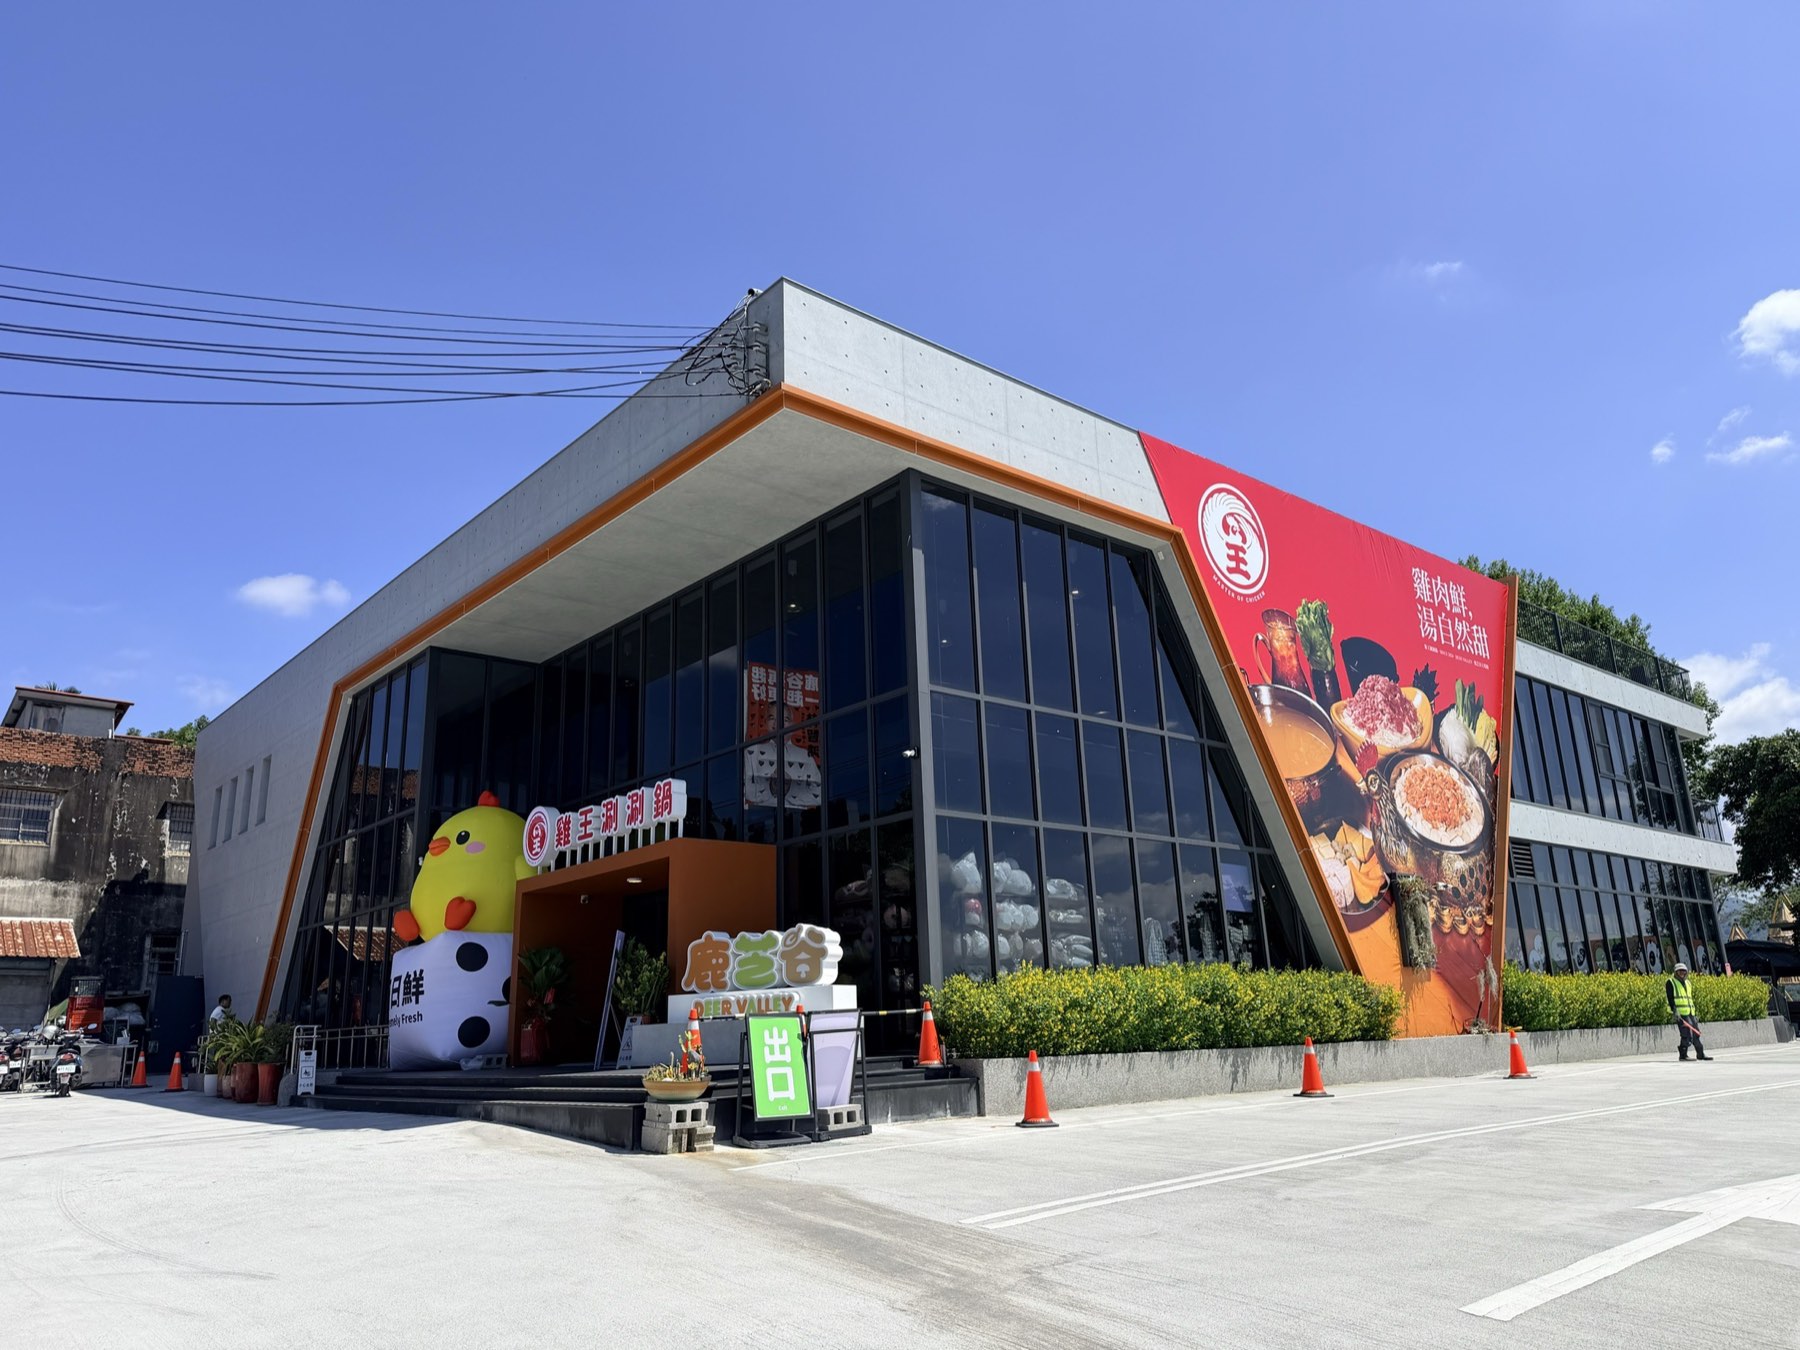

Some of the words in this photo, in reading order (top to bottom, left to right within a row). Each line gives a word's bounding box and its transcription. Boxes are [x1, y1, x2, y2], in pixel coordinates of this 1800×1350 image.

[1212, 573, 1236, 599] MASTER
[1236, 594, 1244, 602] OF
[1411, 566, 1474, 621] 雞肉鮮,
[1416, 602, 1491, 660] 湯自然甜
[555, 780, 672, 849] 雞王涮涮鍋
[681, 923, 830, 993] 鹿芝谷
[401, 1010, 423, 1025] Fresh
[693, 998, 732, 1017] DEER
[736, 994, 795, 1015] VALLEY
[763, 1026, 795, 1102] 出口
